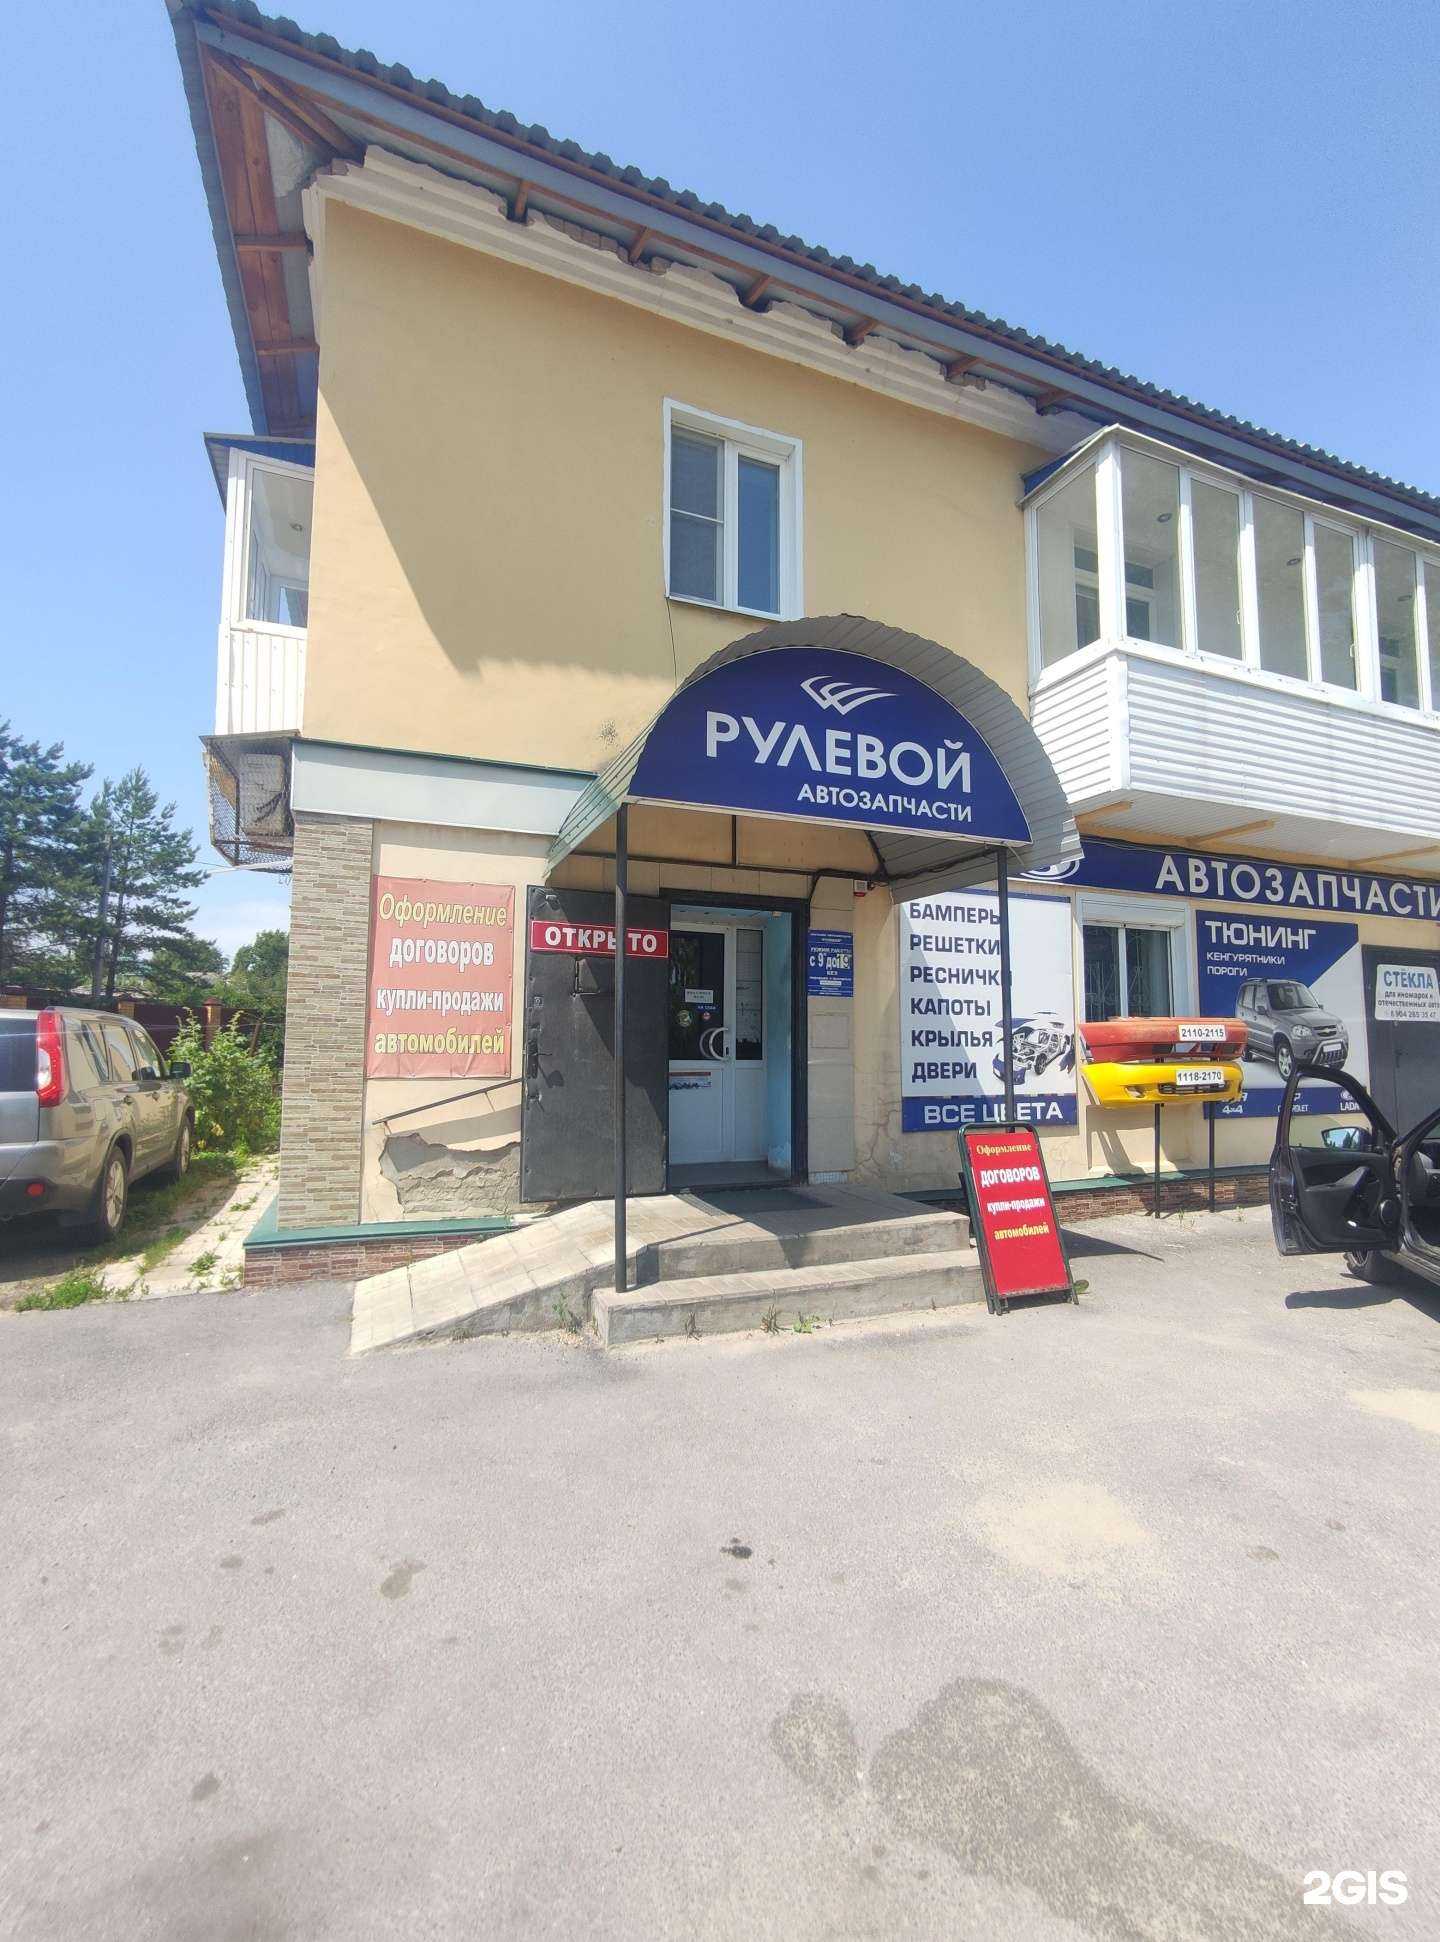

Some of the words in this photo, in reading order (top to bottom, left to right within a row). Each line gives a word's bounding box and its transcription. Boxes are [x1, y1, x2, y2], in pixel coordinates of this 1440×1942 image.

[706, 711, 971, 793] РУЛЕВОЙ
[797, 784, 972, 822] АВТОЗАПЧАСТИ
[379, 893, 507, 928] Оформление
[910, 934, 1000, 955] РЕШЕТКИ
[1204, 920, 1317, 950] ТЮНИНГ
[390, 937, 494, 972] договоров
[1206, 951, 1285, 965] КЕНГУРЯТНИКИ
[1207, 965, 1247, 976] ПОРОГИ
[1383, 970, 1434, 989] СТЕКЛА
[376, 988, 503, 1016] купли-продажи
[910, 997, 991, 1016] КАПОТЫ
[374, 1028, 504, 1055] автомобилей
[911, 1030, 993, 1048] КРЫЛЬЯ
[1181, 1028, 1224, 1038] 2110-2115
[911, 1062, 977, 1084] ДВЕРИ
[1177, 1071, 1222, 1082] 1118-2170
[924, 1104, 976, 1124] ВСЕ
[976, 1143, 1032, 1156] Оформление
[987, 1197, 1046, 1216] купли-продажи
[994, 1222, 1050, 1241] автомобилей
